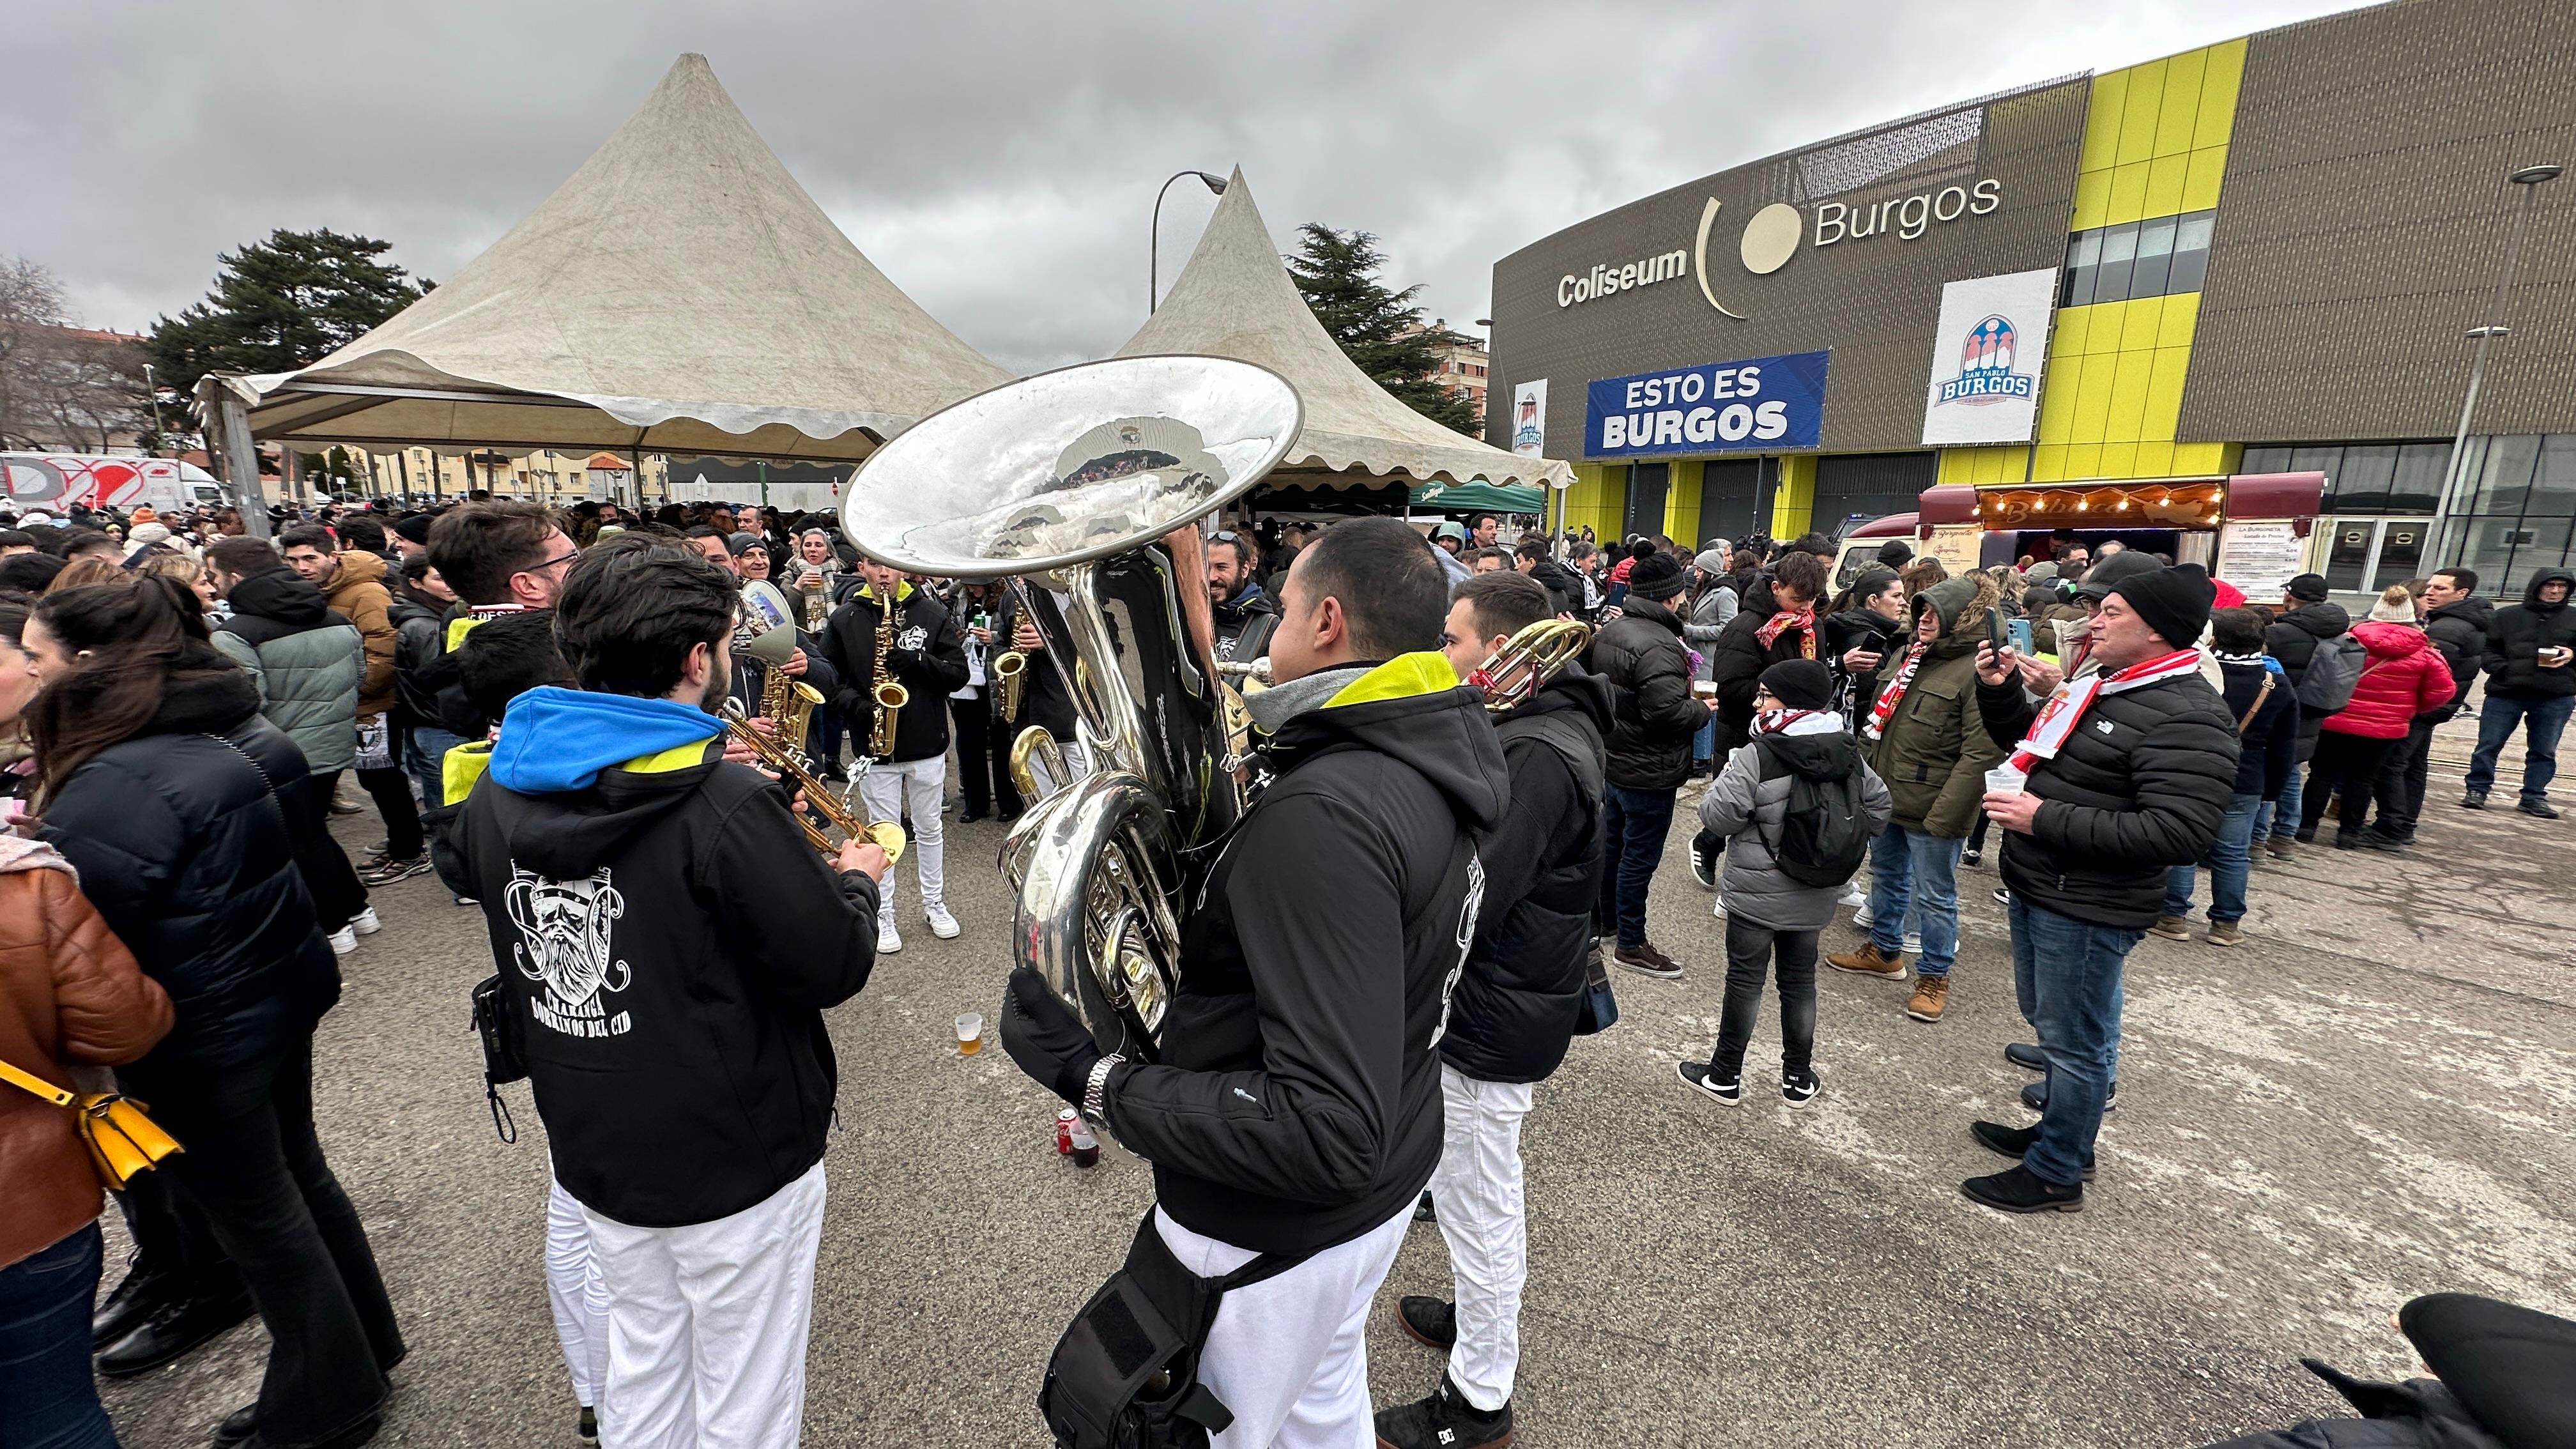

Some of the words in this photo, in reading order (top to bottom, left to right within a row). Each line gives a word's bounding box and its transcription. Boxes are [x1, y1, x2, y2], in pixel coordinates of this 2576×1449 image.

[1558, 249, 1687, 309] Coliseum
[1814, 178, 2000, 247] Burgos
[1625, 372, 1705, 410] ESTO
[1713, 366, 1761, 400] ES
[1943, 376, 2028, 400] BURGOS
[1516, 433, 1541, 447] BURGOS
[1602, 400, 1788, 449] BURGOS
[531, 995, 585, 1038] SOBRINOS
[586, 1018, 609, 1038] DEL
[611, 1010, 631, 1036] CID
[545, 986, 606, 1018] CHARANGA
